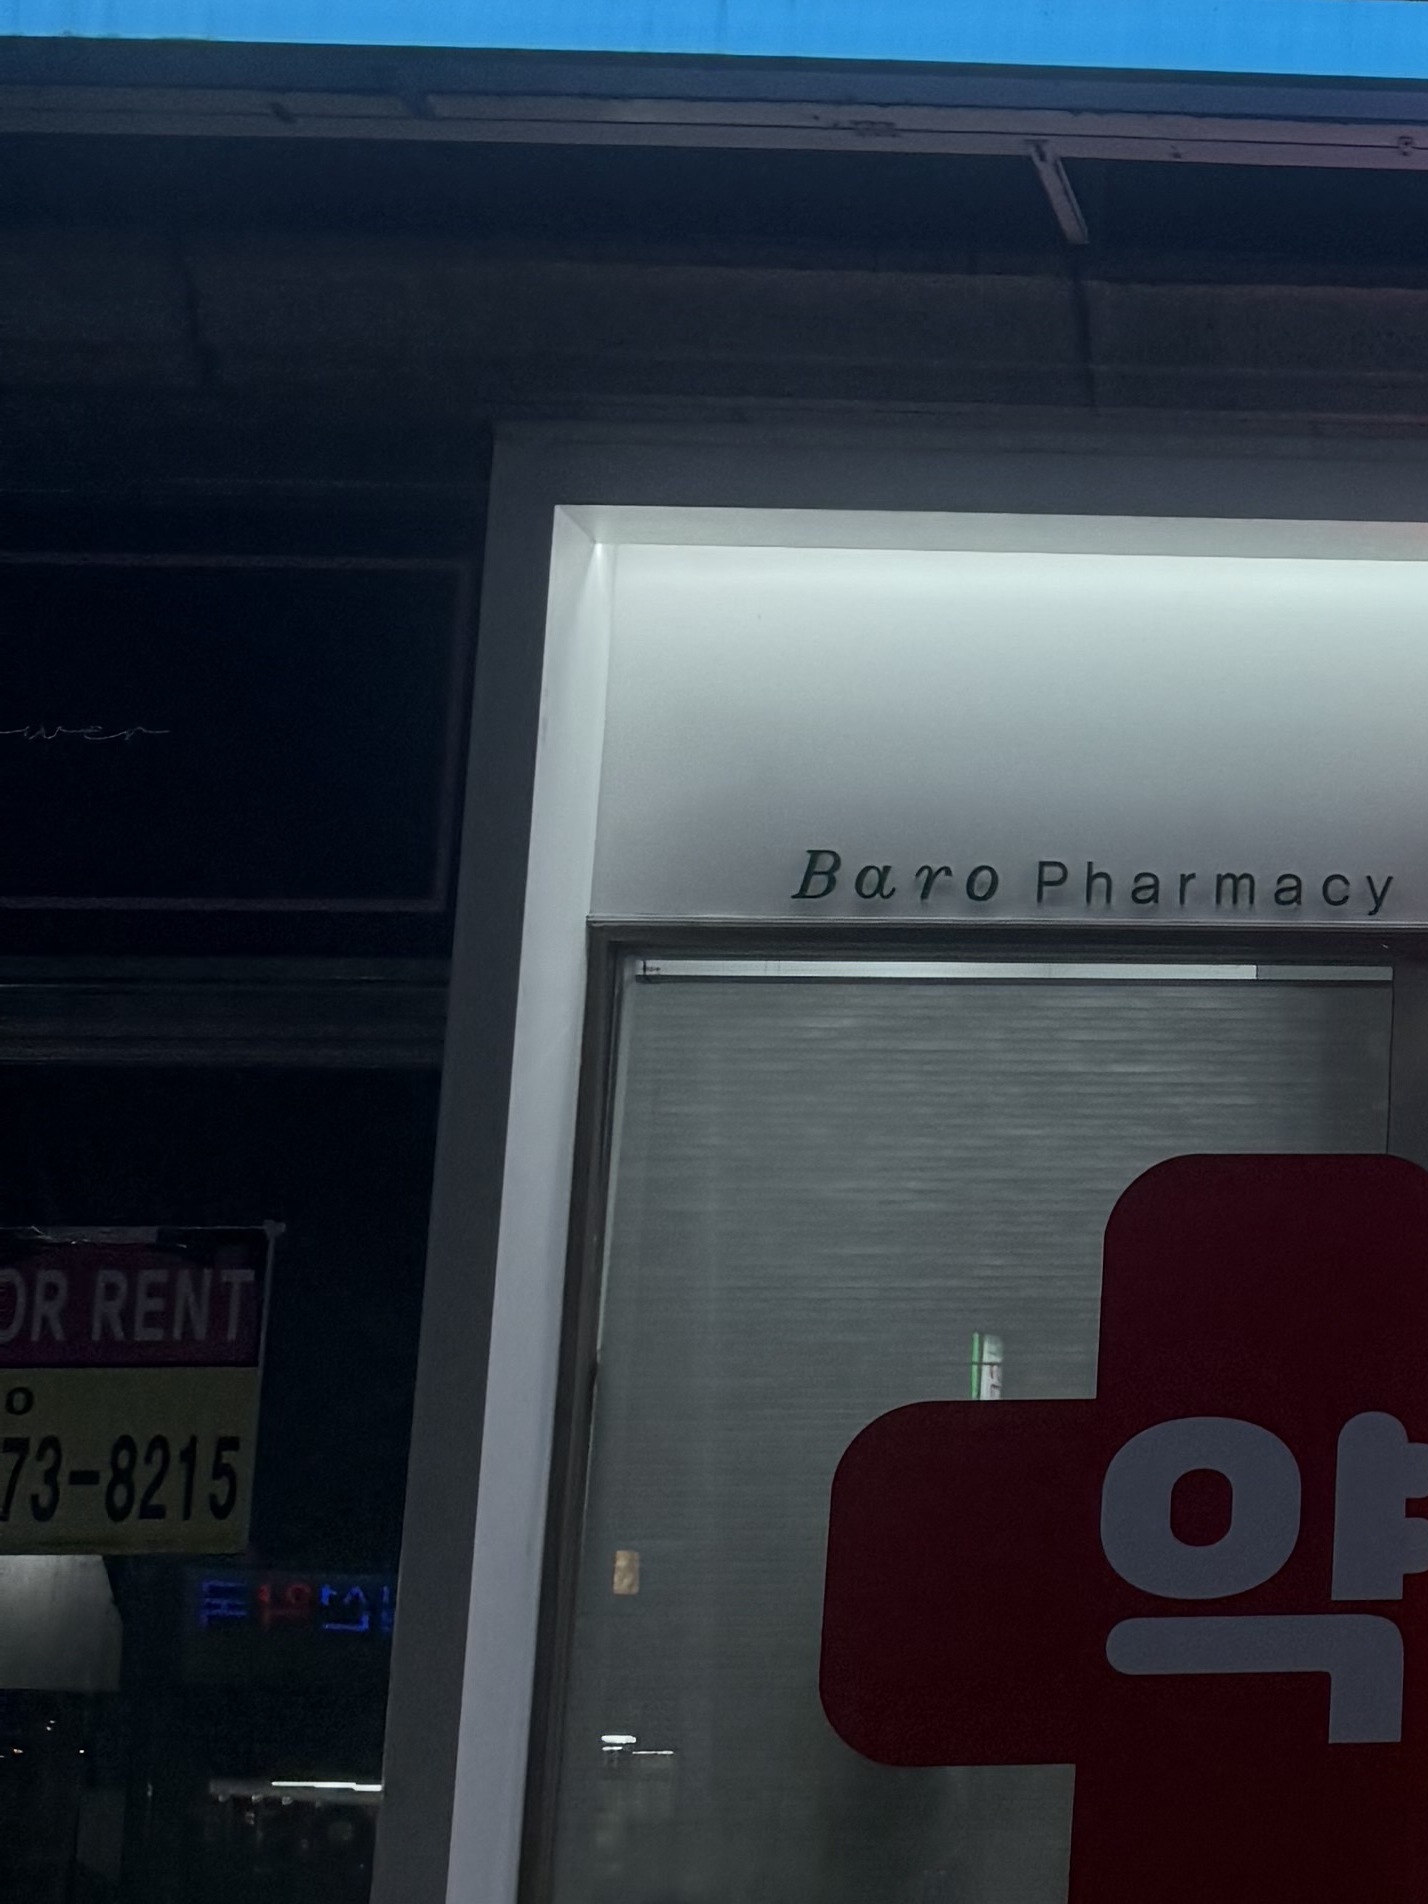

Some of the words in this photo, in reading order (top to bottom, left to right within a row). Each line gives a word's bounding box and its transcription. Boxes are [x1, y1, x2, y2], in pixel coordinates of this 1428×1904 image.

[792, 848, 1000, 902] Baro
[1035, 859, 1396, 916] Pharmacy
[91, 1268, 257, 1342] RENT
